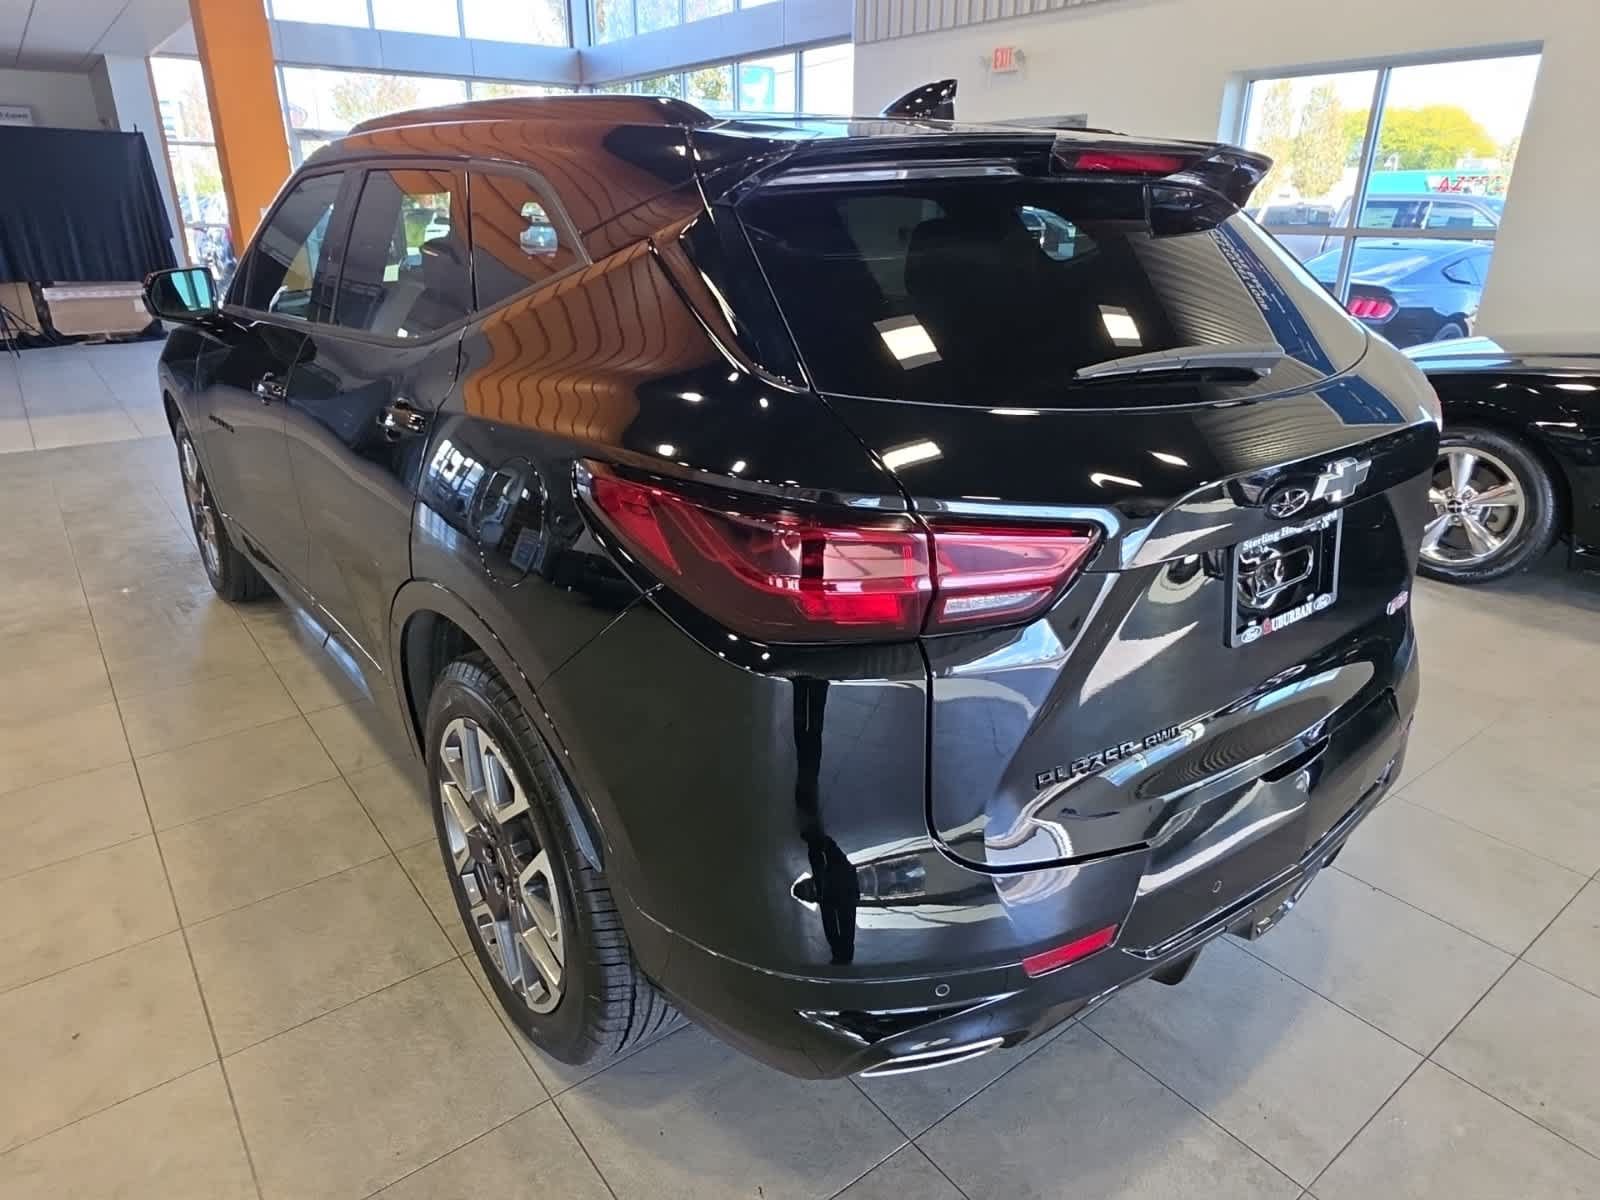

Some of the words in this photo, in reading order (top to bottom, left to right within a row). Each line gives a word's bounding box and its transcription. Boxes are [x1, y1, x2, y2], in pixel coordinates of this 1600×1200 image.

[993, 47, 1014, 69] EXIT
[1242, 529, 1280, 551] Sterling
[1263, 602, 1313, 635] SUBURBAN
[1036, 740, 1136, 789] BLAZER
[1143, 724, 1183, 749] AWD
